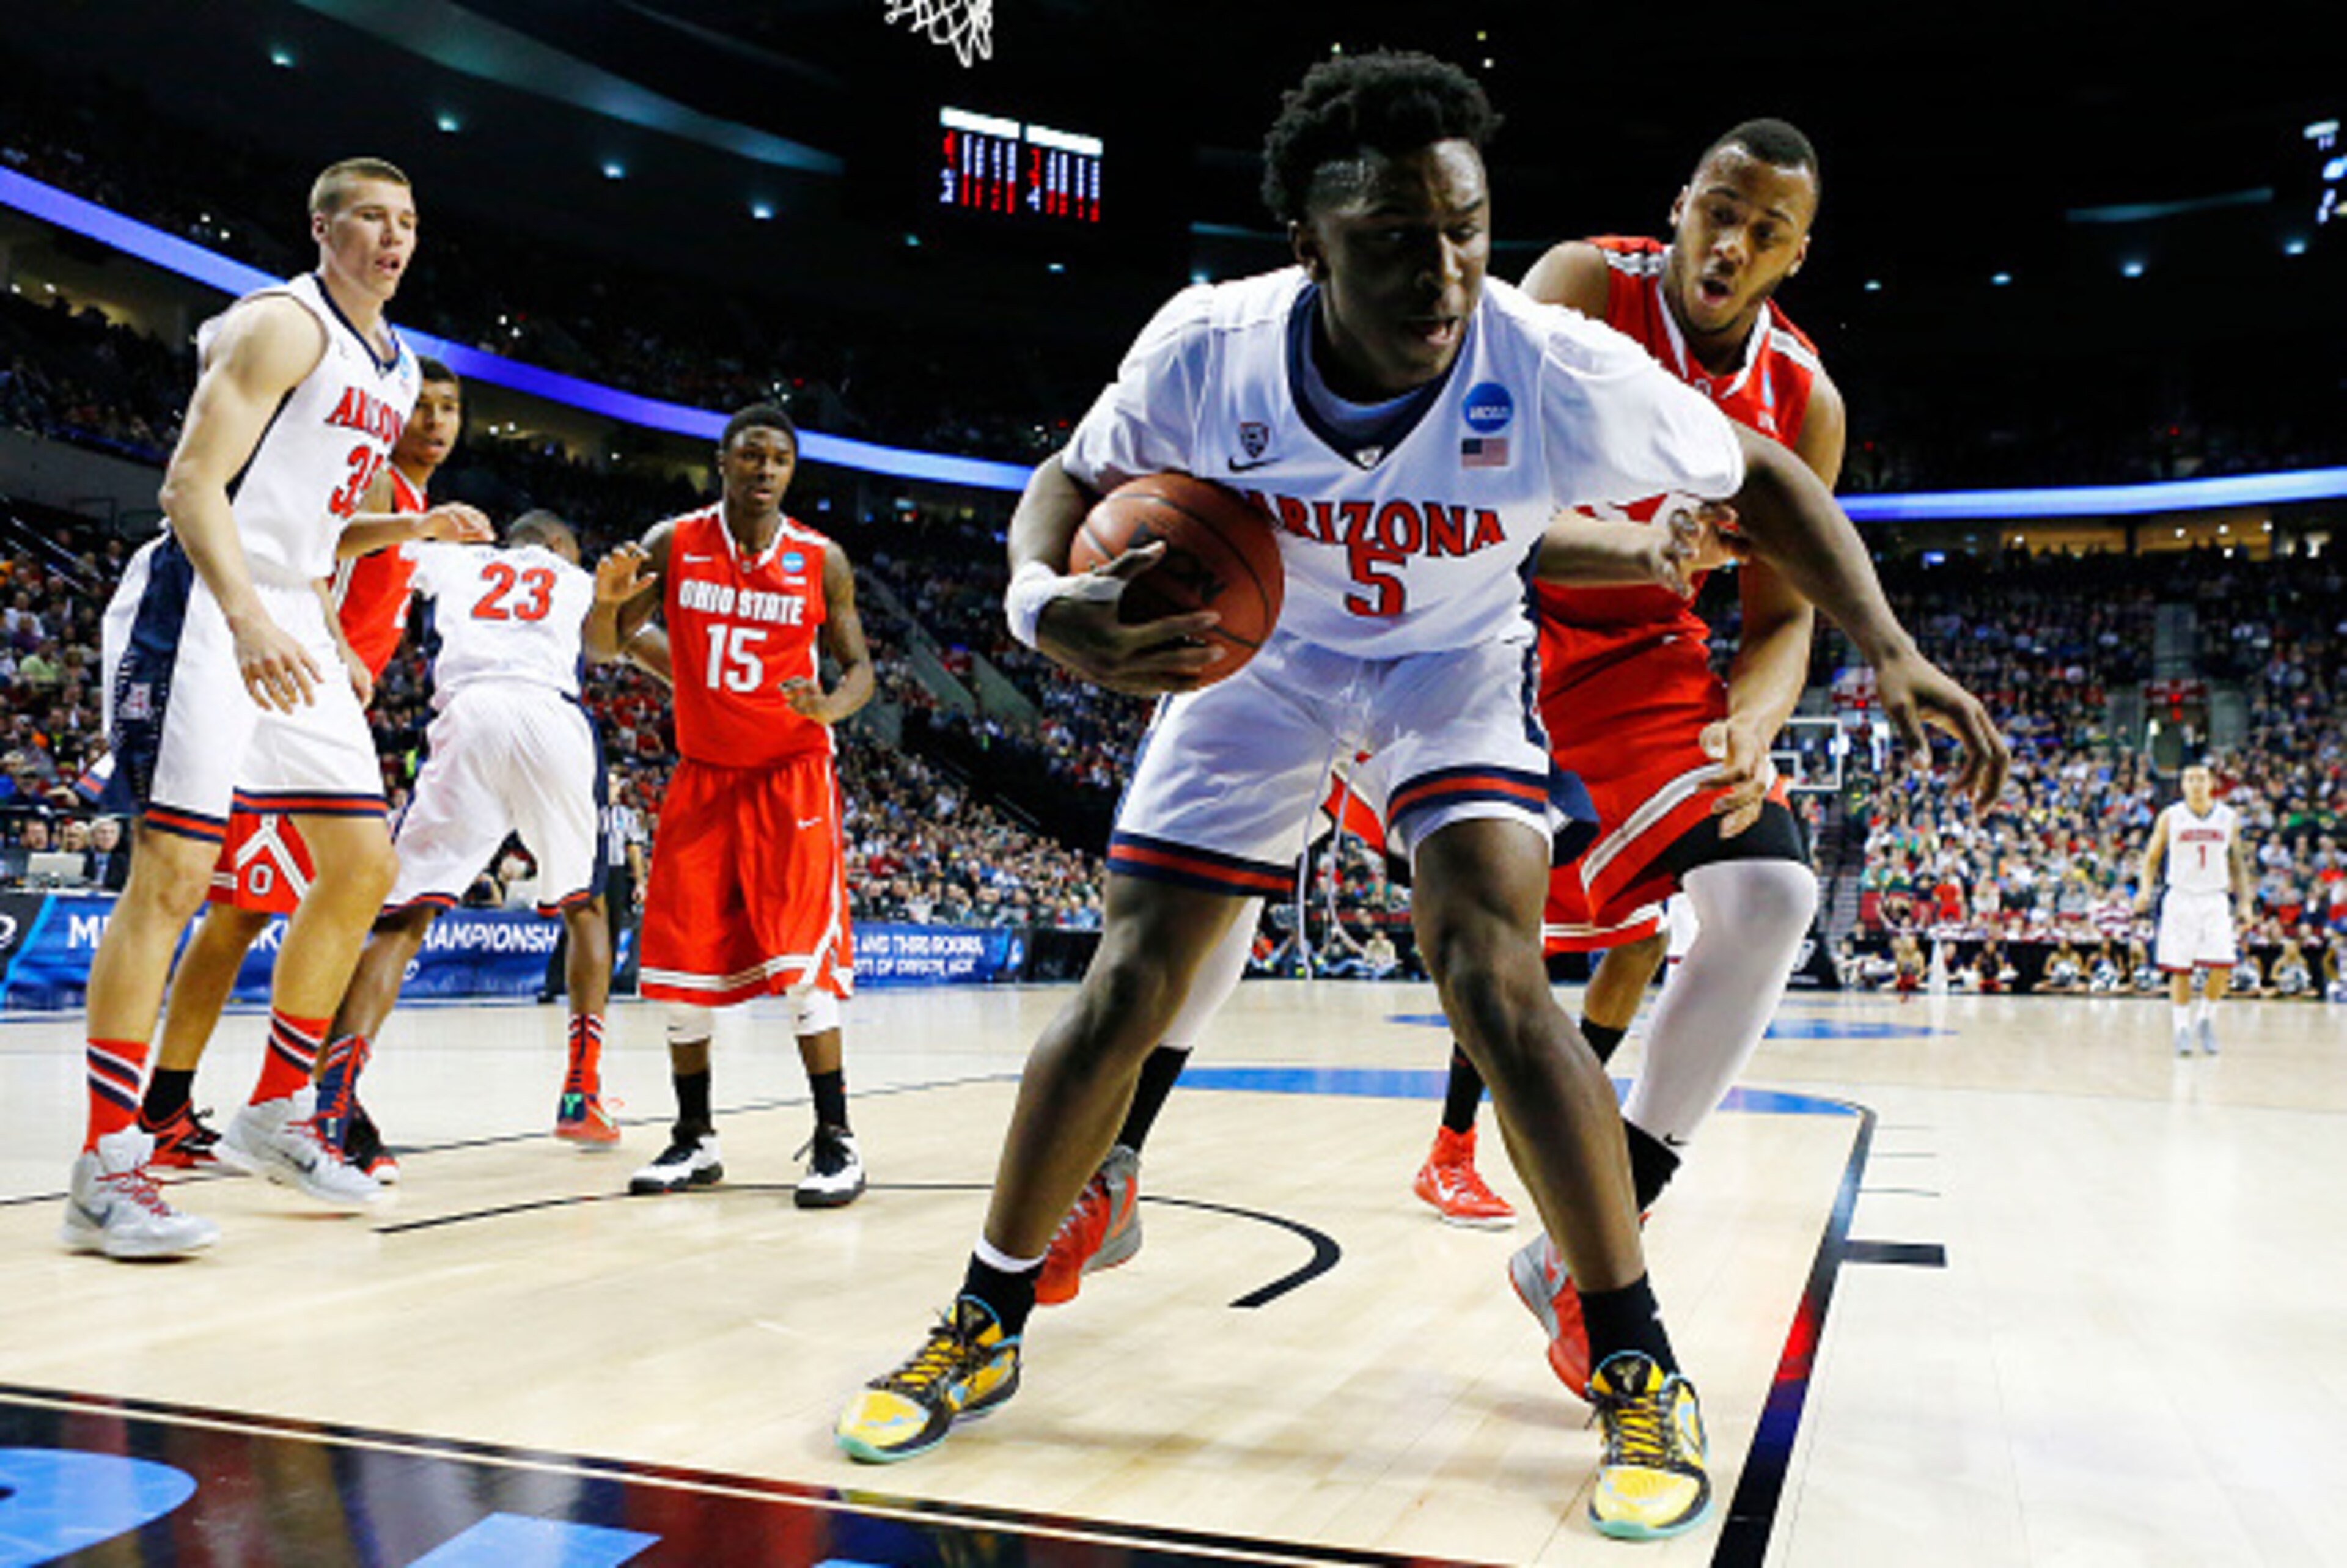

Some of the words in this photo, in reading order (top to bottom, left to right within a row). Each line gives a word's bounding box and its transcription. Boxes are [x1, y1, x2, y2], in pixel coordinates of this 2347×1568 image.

[470, 561, 557, 621] 23
[679, 577, 735, 617] OHIO
[738, 588, 806, 626] STATE
[1346, 540, 1406, 617] 5
[706, 623, 767, 692] 15
[2197, 844, 2206, 870] 1
[422, 921, 562, 953] HAMPIONSH
